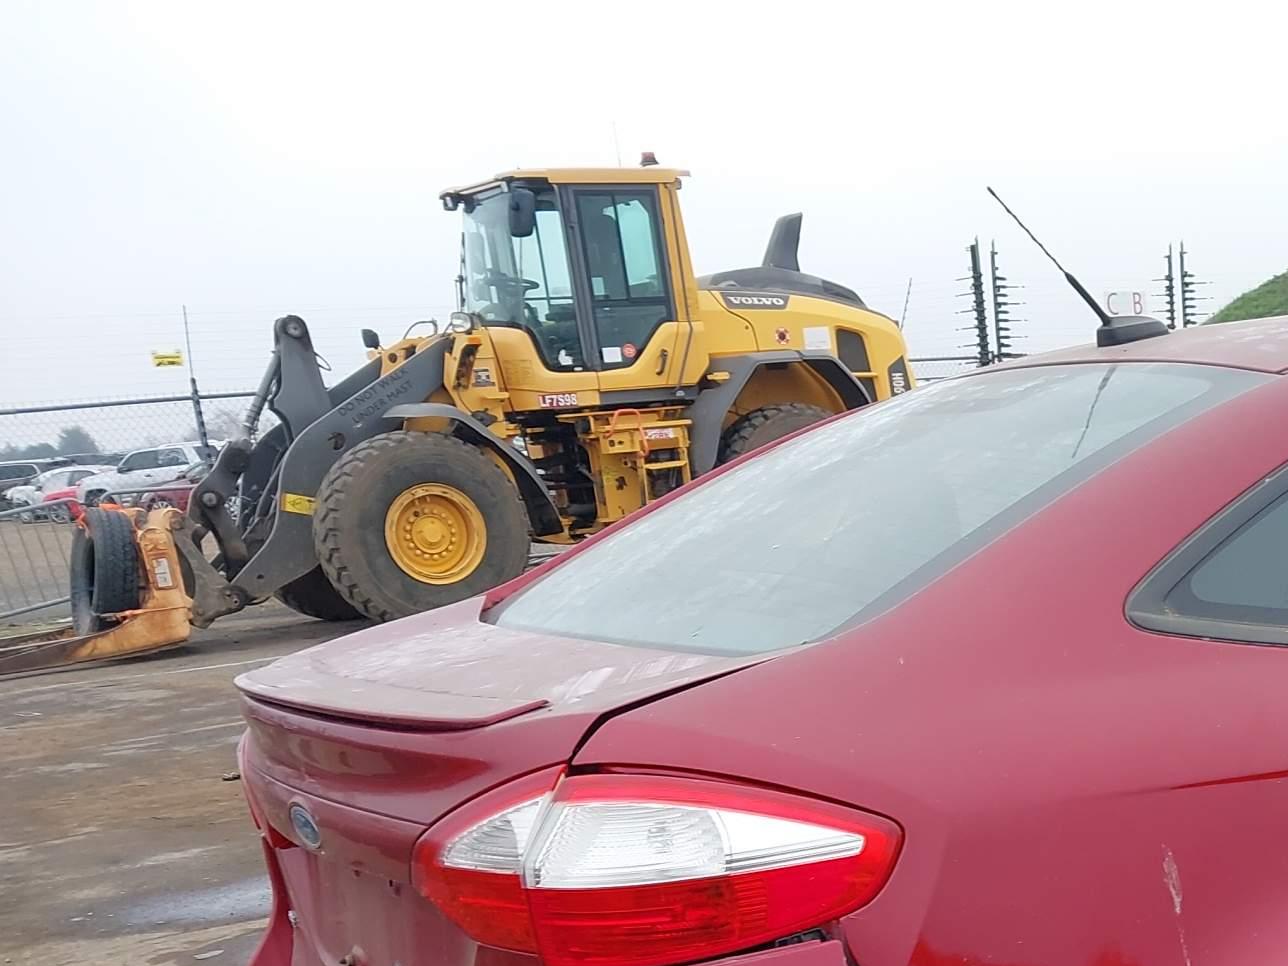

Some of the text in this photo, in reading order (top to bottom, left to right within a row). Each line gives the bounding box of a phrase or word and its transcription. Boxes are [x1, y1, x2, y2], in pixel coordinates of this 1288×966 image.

[727, 296, 785, 306] VOLVO
[338, 368, 409, 416] DO NOT WALK
[352, 381, 414, 423] UNDER MAST
